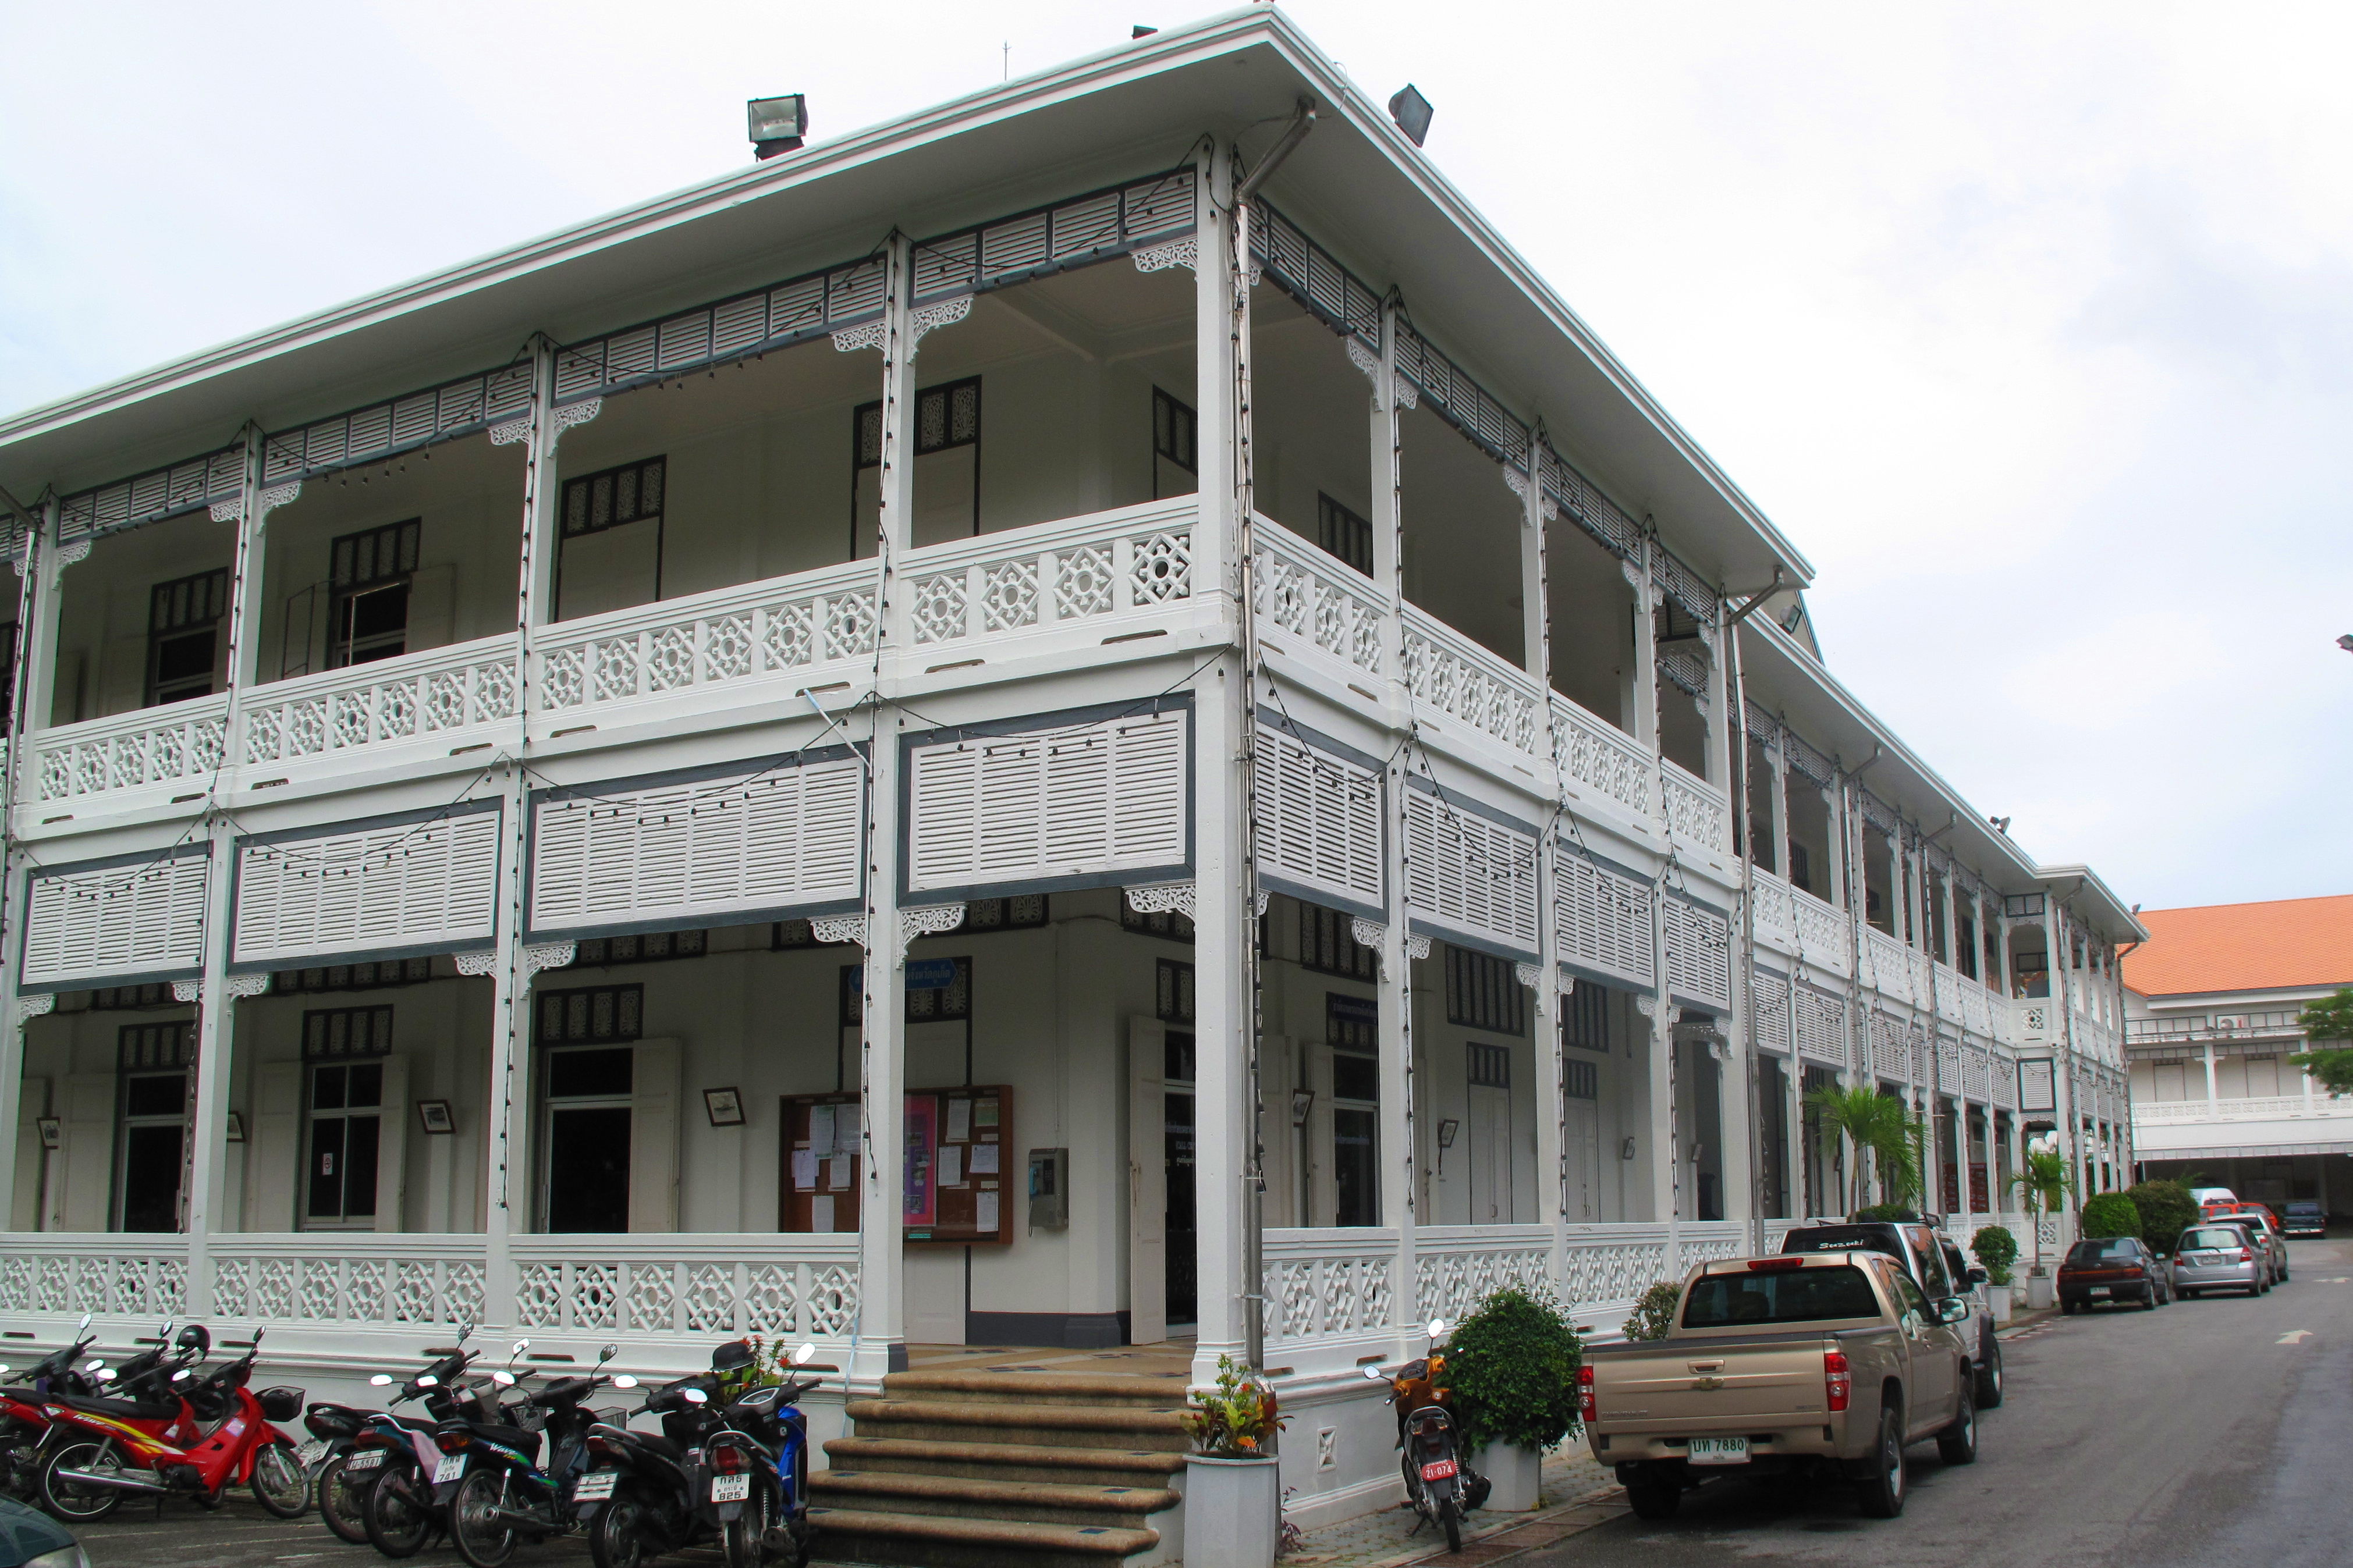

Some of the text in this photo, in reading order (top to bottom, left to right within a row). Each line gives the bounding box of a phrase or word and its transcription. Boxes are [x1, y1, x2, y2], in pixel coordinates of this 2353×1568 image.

[1819, 1239, 1864, 1249] Suzuki
[489, 1442, 518, 1455] Wave
[1715, 1439, 1744, 1452] 7880
[439, 1471, 456, 1482] 741
